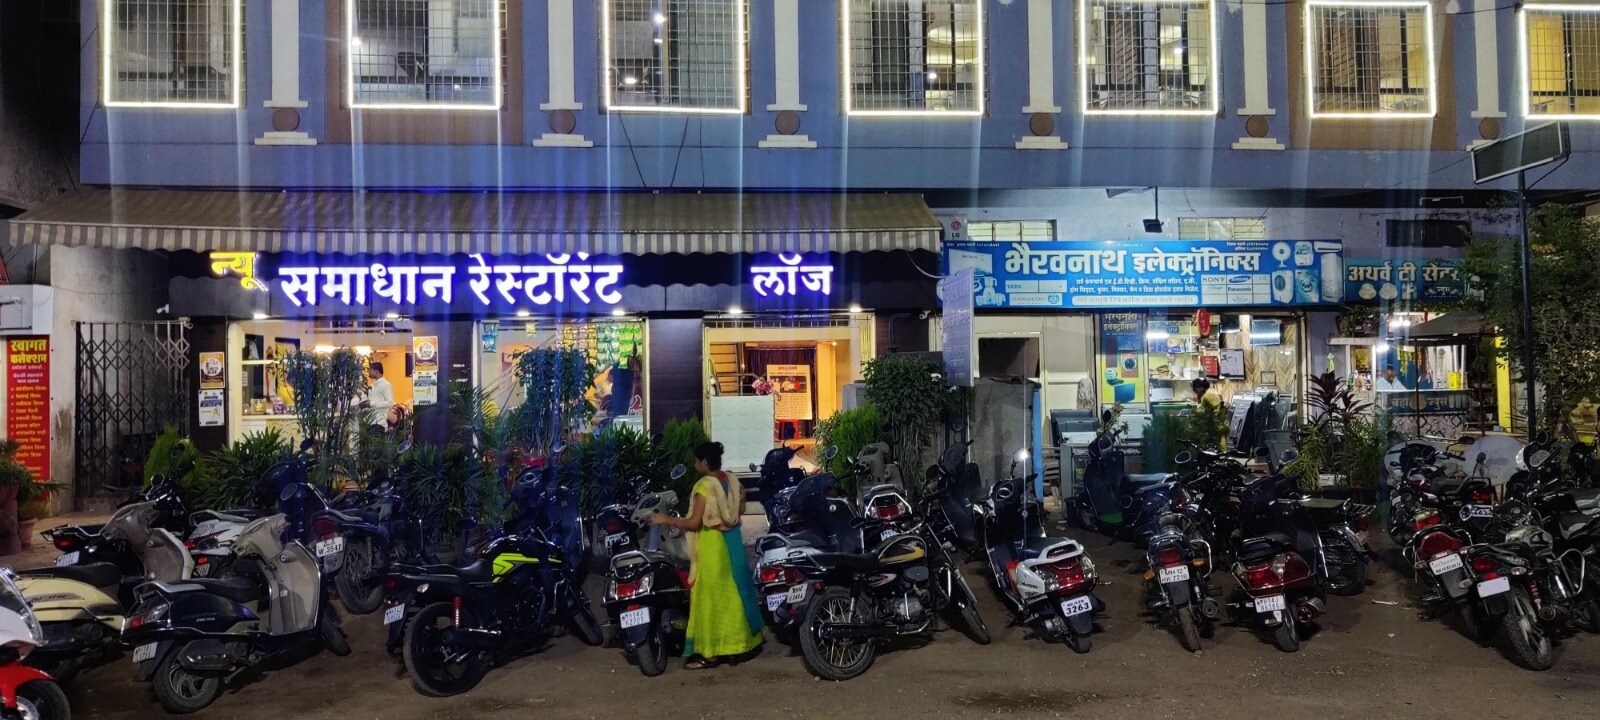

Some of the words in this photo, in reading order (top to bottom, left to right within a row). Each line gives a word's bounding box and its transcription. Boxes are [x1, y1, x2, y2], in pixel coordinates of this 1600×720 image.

[210, 252, 269, 292] न्यू
[750, 254, 834, 297] लॉज
[1005, 243, 1127, 275] भैरवनाथ
[1131, 247, 1262, 276] इलेक्ट्रॉनिक्स
[1348, 260, 1393, 281] अथर्व
[1397, 262, 1417, 281] टी
[279, 263, 456, 306] समाधान
[468, 252, 624, 305] रेस्टॉरंट
[10, 339, 47, 351] स्वागत
[1066, 602, 1090, 615] 3263
